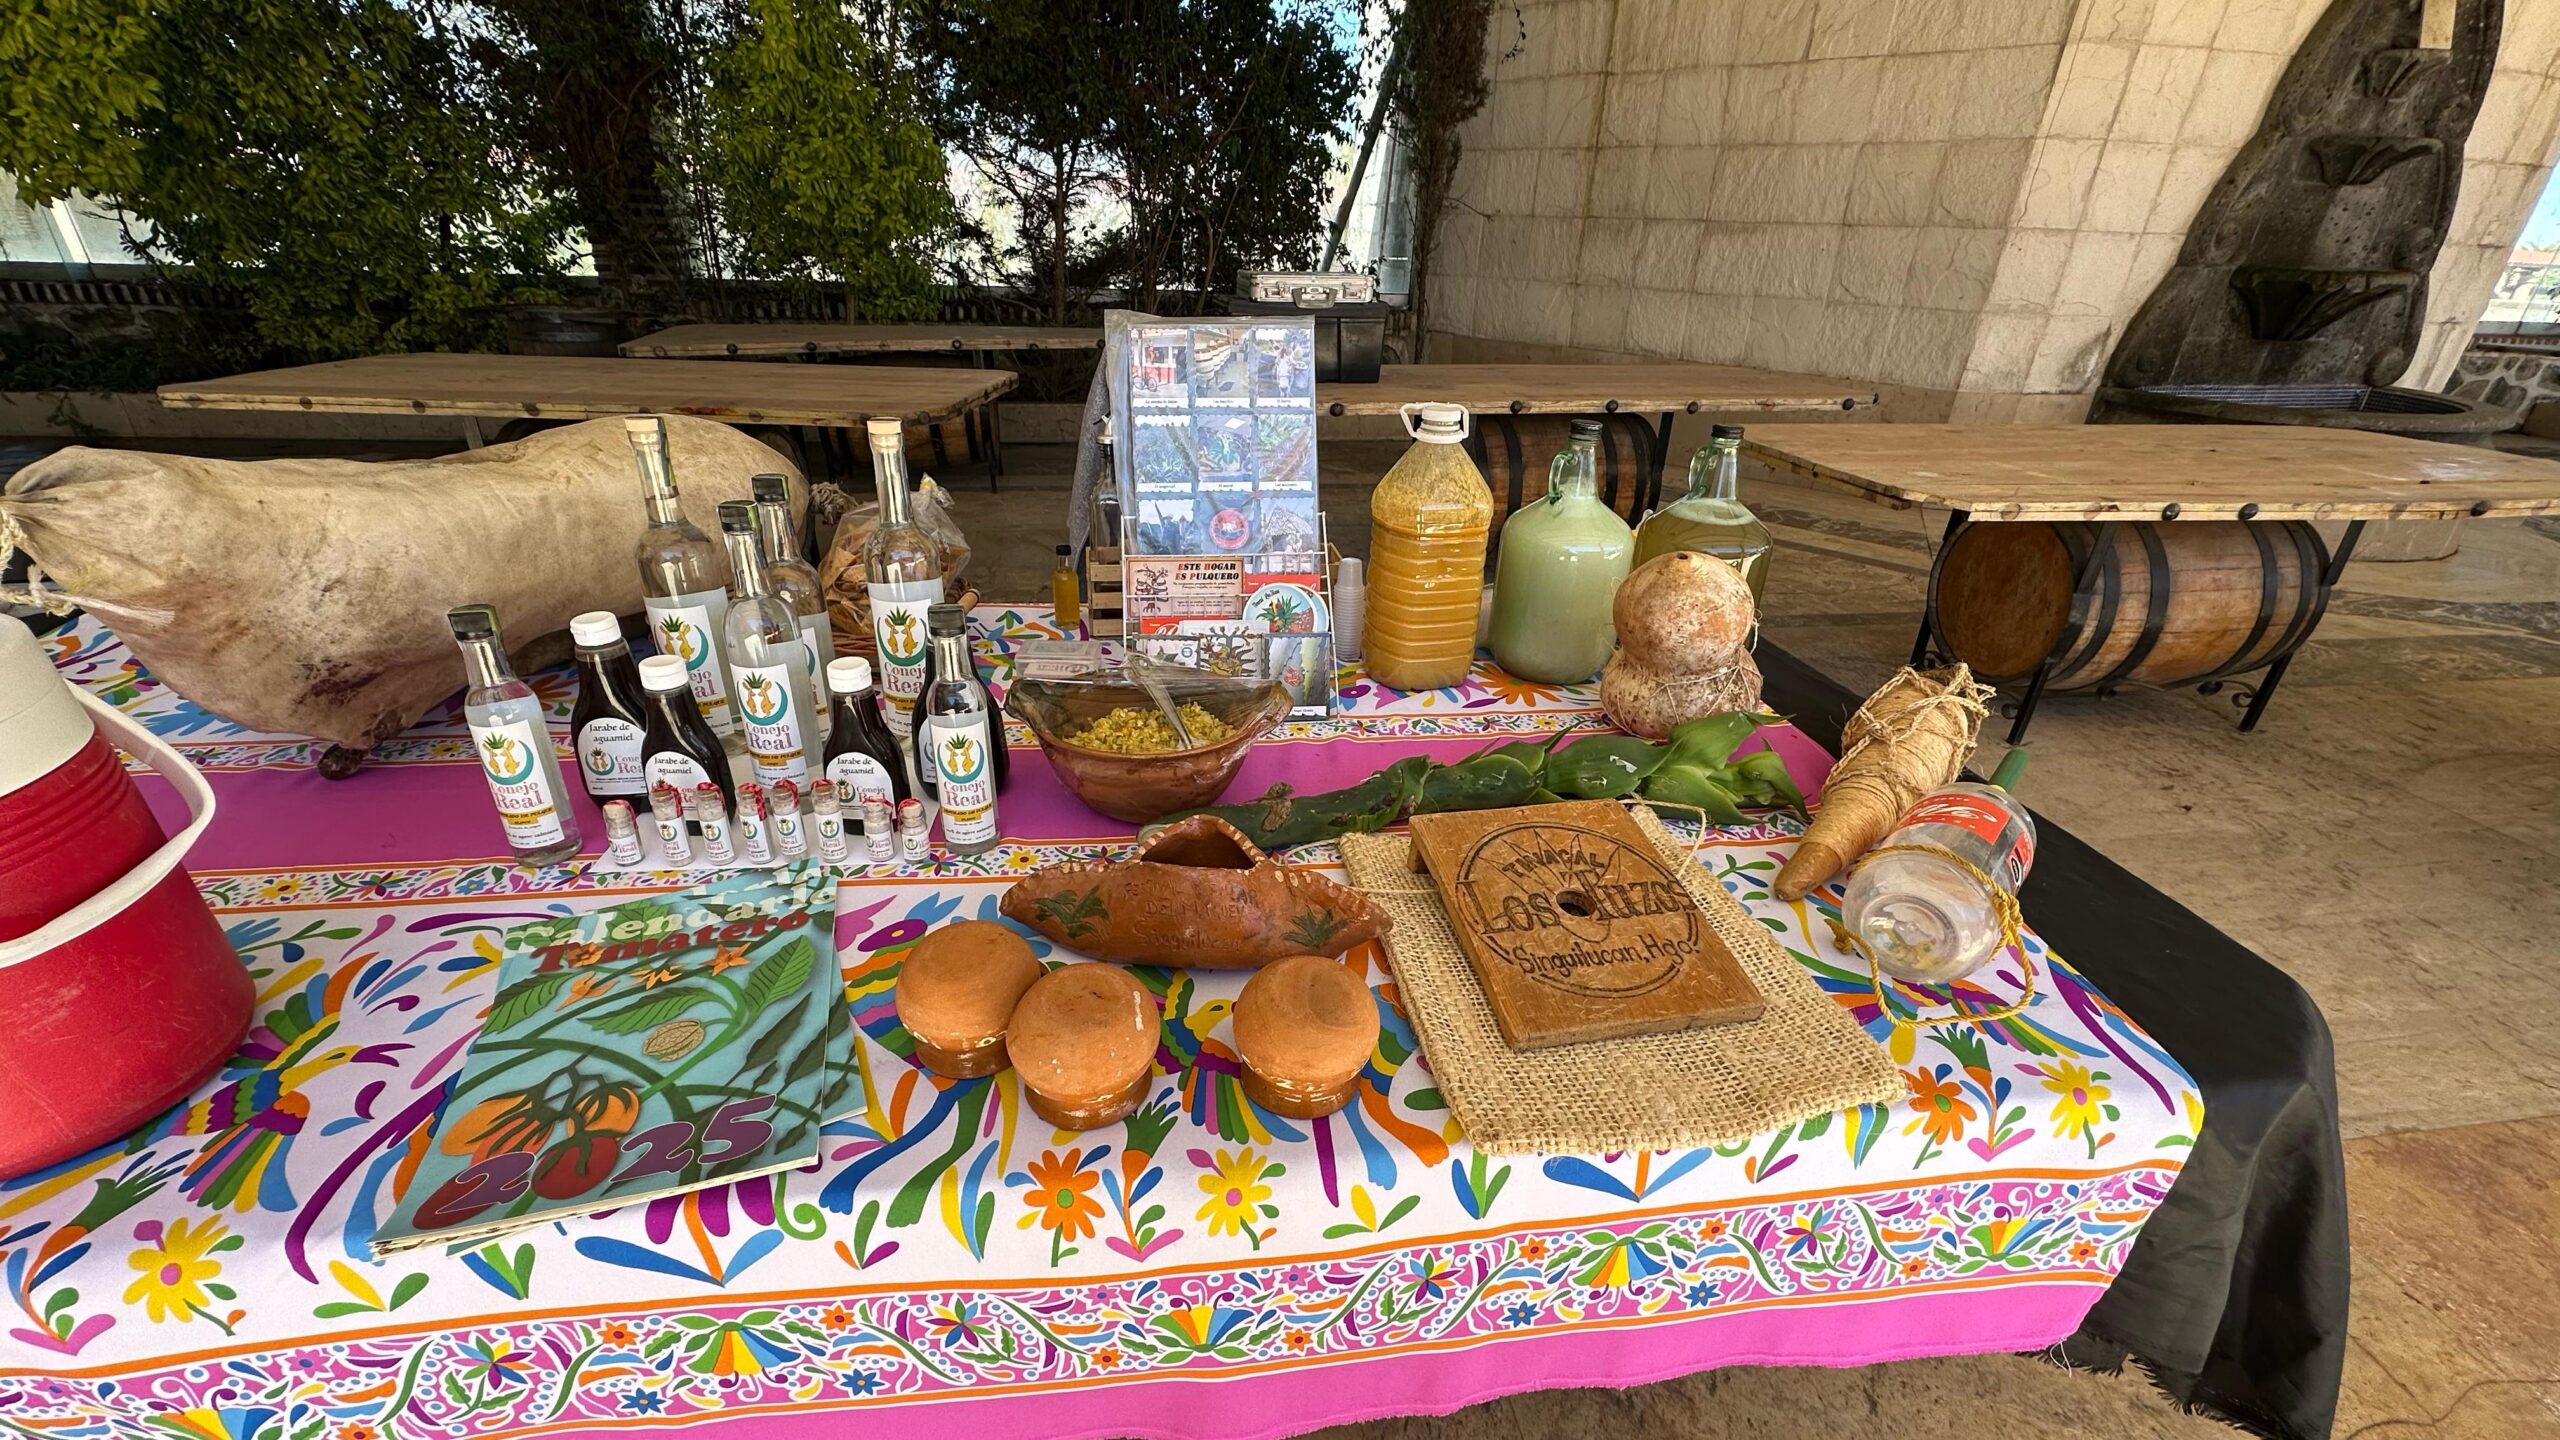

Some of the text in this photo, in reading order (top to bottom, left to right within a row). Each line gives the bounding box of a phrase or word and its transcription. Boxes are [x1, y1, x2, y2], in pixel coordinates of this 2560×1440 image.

[1178, 563, 1236, 571] ESTE HOGAR
[1190, 572, 1239, 580] PULQUERO
[690, 669, 711, 684] ejo
[886, 673, 924, 694] Rea
[694, 679, 718, 698] al
[589, 723, 630, 733] Jarabe de
[746, 722, 790, 738] Conejo
[593, 732, 635, 745] aguamiel
[749, 732, 795, 751] Real
[615, 755, 640, 763] Cone
[654, 757, 678, 765] Jarabe
[837, 757, 861, 765] Jarabe
[657, 767, 692, 776] aguamiel
[839, 767, 875, 776] aguamiel
[490, 781, 539, 796] Conejo
[856, 785, 885, 795] Conejo
[943, 779, 985, 793] Conejo
[494, 789, 545, 809] Real
[944, 787, 988, 807] Real
[1502, 849, 1605, 878] TINACAL
[435, 1093, 778, 1215] 2025
